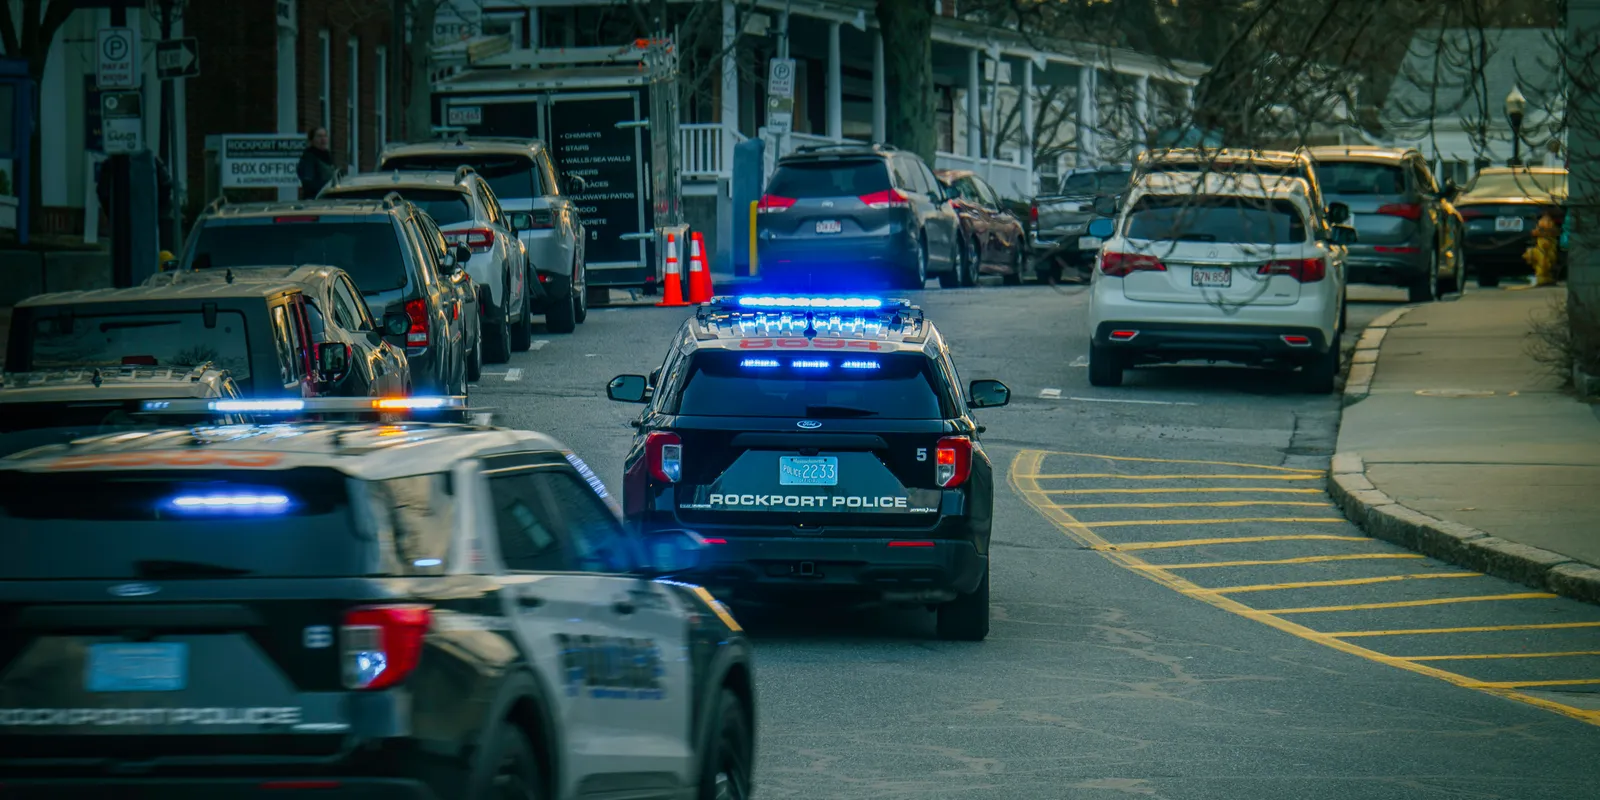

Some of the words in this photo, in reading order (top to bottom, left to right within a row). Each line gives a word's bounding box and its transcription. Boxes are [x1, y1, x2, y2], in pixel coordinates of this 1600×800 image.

[102, 62, 117, 71] PAY
[119, 62, 130, 70] AT
[564, 131, 602, 140] CHIMNEYS
[228, 139, 276, 151] ROCKPORT
[565, 144, 589, 152] STAIRS
[607, 155, 631, 163] WALLS
[231, 162, 257, 175] BOX
[258, 162, 299, 175] OFFIC
[578, 218, 607, 226] NCRETE
[739, 337, 882, 351] 8694
[916, 447, 927, 462] 5
[783, 464, 802, 478] POLICE
[802, 464, 835, 479] 2233
[709, 493, 828, 507] ROCKPORT
[832, 496, 907, 508] POLICE
[0, 707, 164, 725] OCKPORT
[167, 707, 302, 724] POLICE
